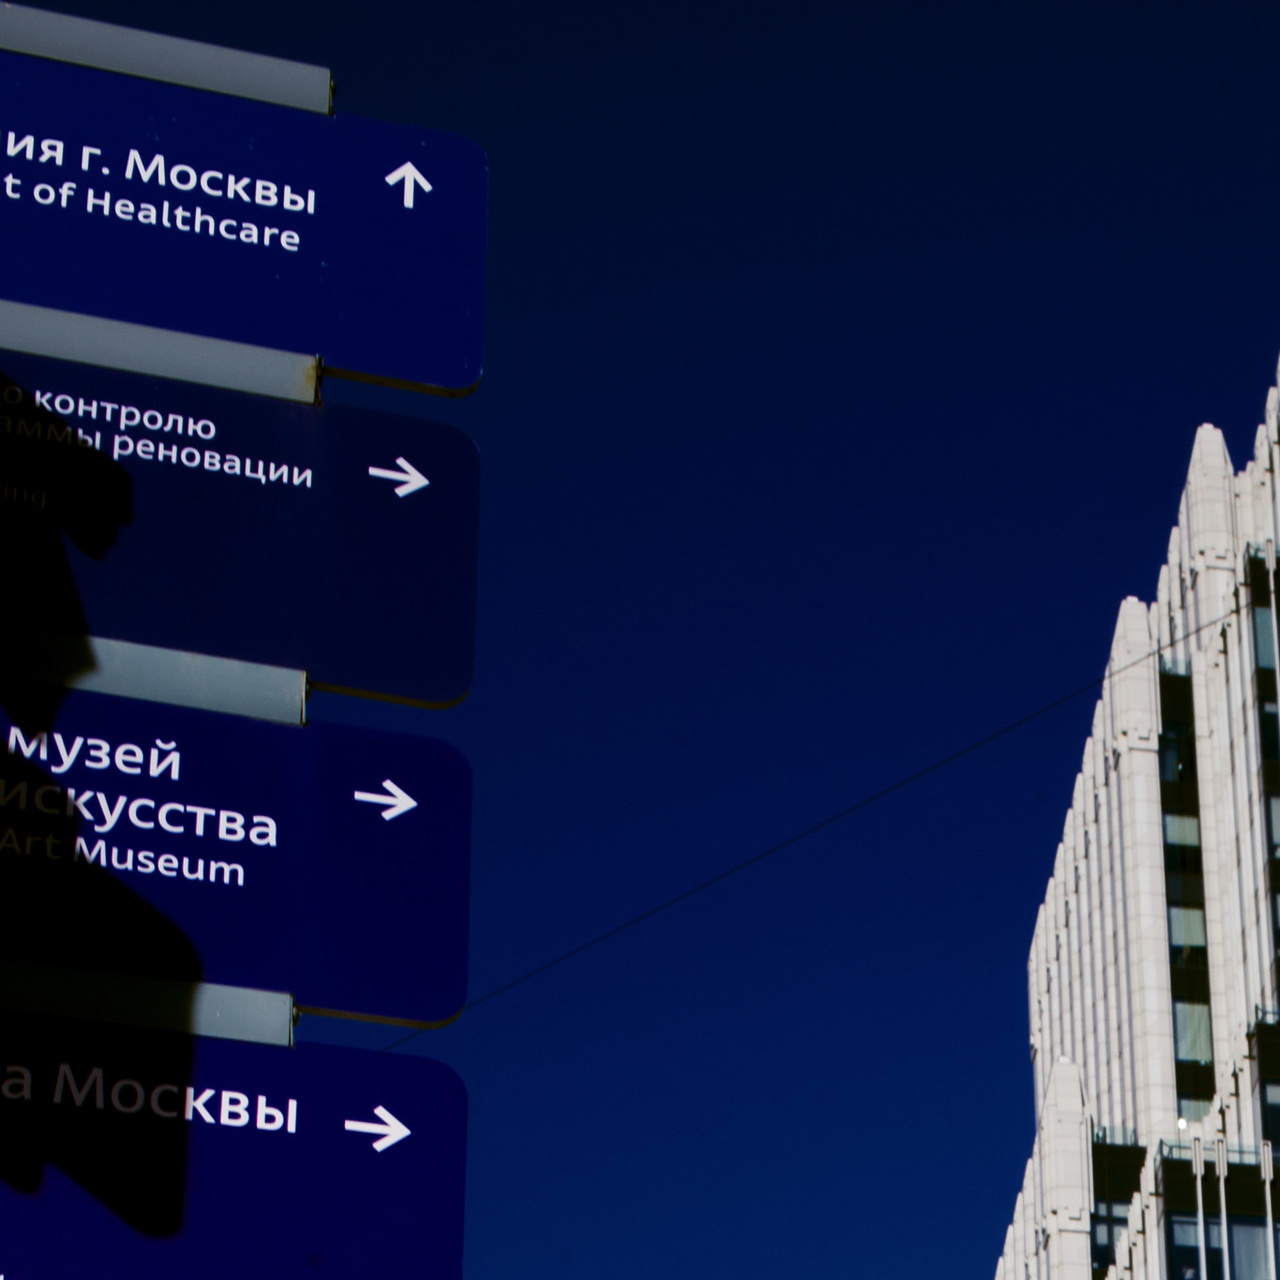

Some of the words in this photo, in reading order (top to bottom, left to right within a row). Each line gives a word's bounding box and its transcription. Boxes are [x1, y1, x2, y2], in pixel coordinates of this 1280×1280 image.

[81, 145, 110, 175] г.
[125, 148, 316, 214] Москвы
[33, 181, 77, 208] of
[86, 187, 300, 252] Healthcare
[34, 388, 217, 440] контролю
[113, 432, 313, 489] реновации
[7, 725, 181, 780] музей
[0, 777, 278, 847] искусства
[73, 836, 245, 887] Museum
[52, 1061, 297, 1133] Москвы
